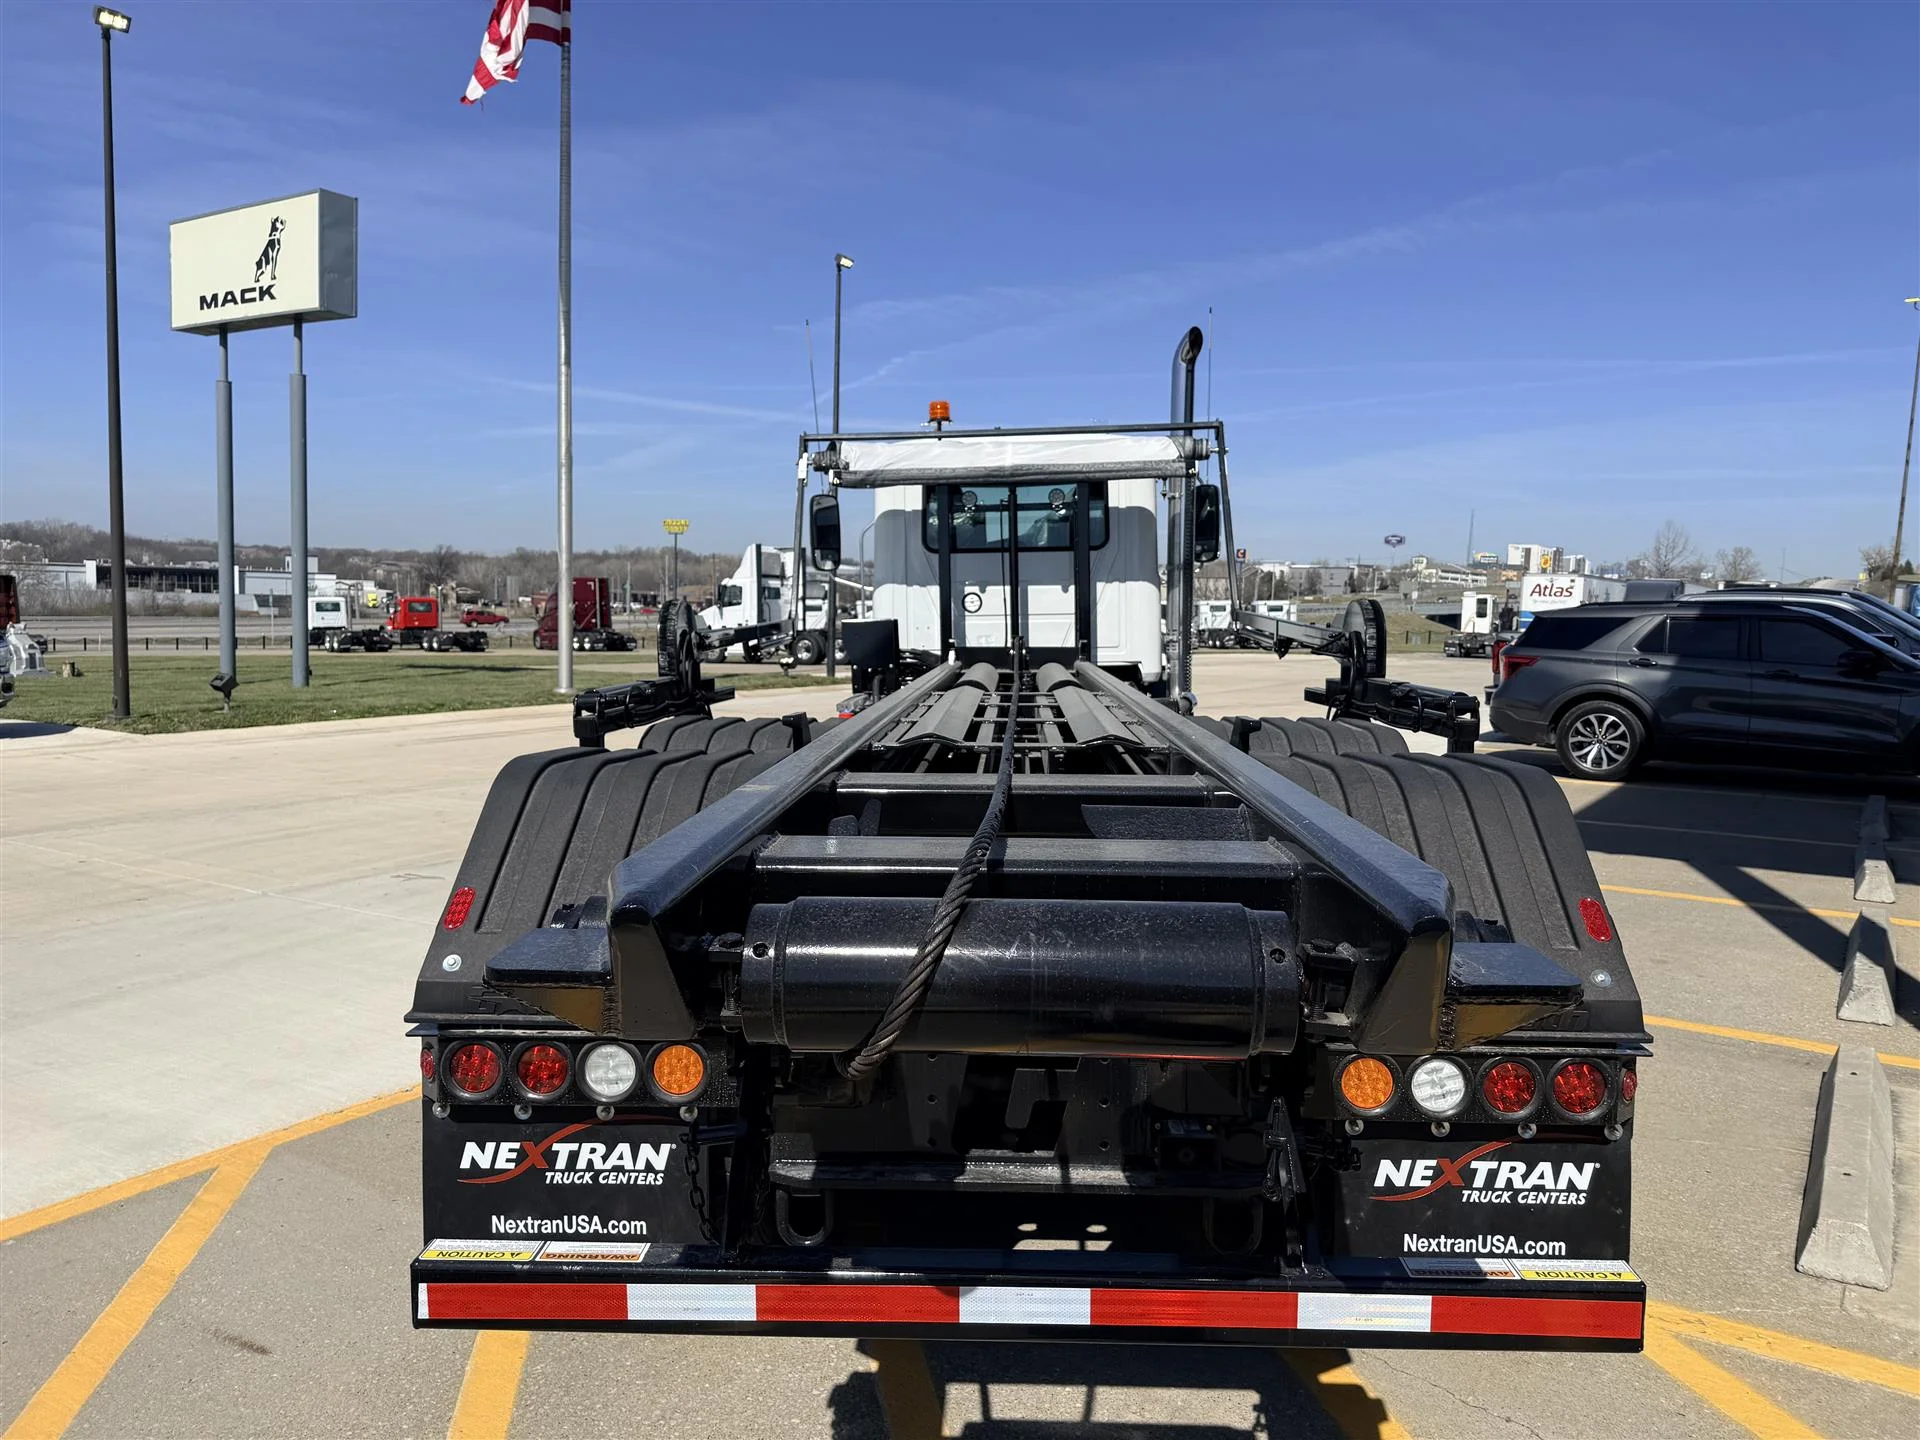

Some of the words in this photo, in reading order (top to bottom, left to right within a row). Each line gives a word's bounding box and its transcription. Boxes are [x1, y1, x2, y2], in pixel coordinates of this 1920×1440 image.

[199, 284, 277, 311] MACK
[1530, 583, 1574, 598] Atlas
[458, 1141, 672, 1171] NEXTRAN
[544, 1171, 594, 1185] TRUCK
[599, 1171, 665, 1186] CENTERS
[1373, 1158, 1596, 1191] NEXTRAN
[1461, 1190, 1512, 1204] TRUCK
[1517, 1191, 1588, 1206] CENTERS
[491, 1214, 648, 1235] NextranUSA.com
[1403, 1233, 1567, 1256] NextranUSA.com
[436, 1250, 506, 1258] CAUTION
[544, 1252, 625, 1260] WARNING
[1534, 1271, 1608, 1279] CAUTION
